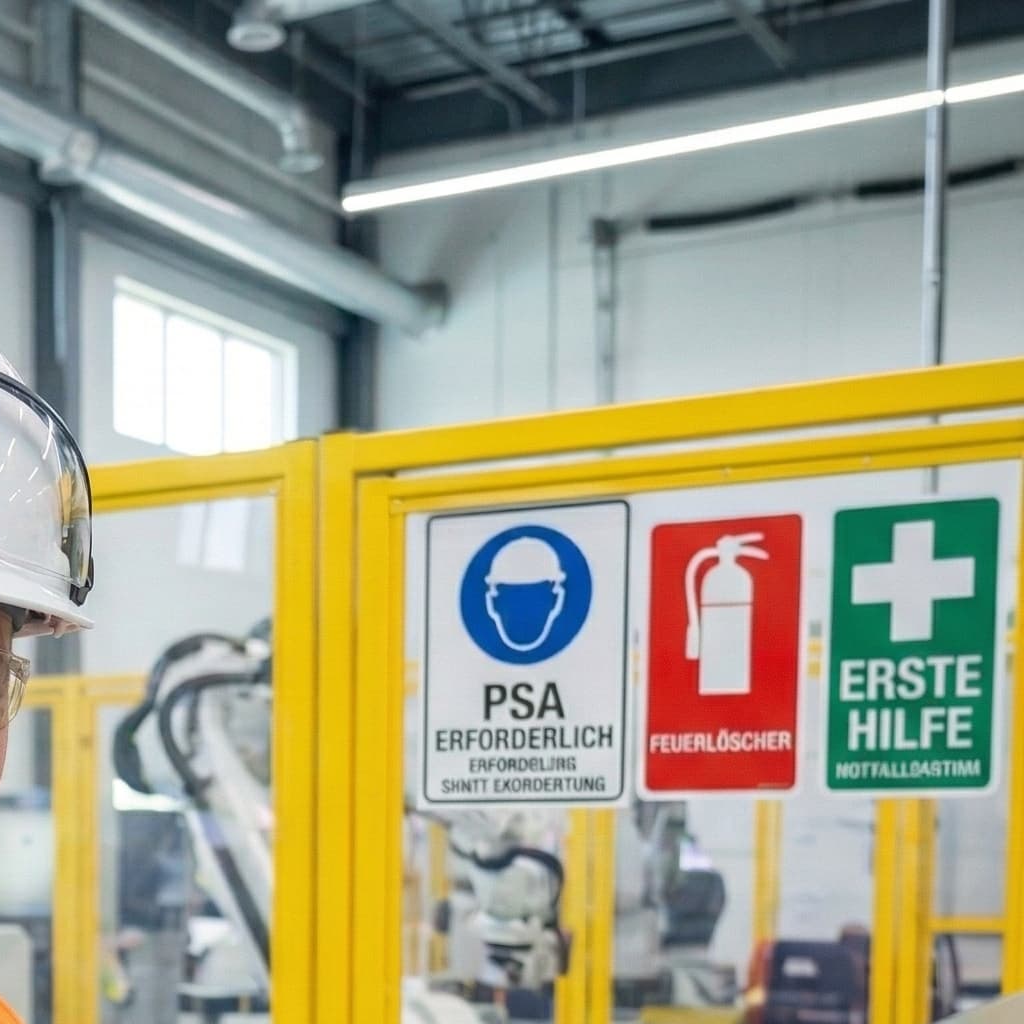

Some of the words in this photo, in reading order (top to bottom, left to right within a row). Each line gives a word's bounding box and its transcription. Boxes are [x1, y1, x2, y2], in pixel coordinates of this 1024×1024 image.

[839, 654, 983, 701] ERSTE
[483, 682, 565, 721] PSA
[435, 725, 613, 751] ERFORDERLICH
[649, 728, 792, 754] FEUERLÖSCHER
[847, 706, 974, 751] HILFE
